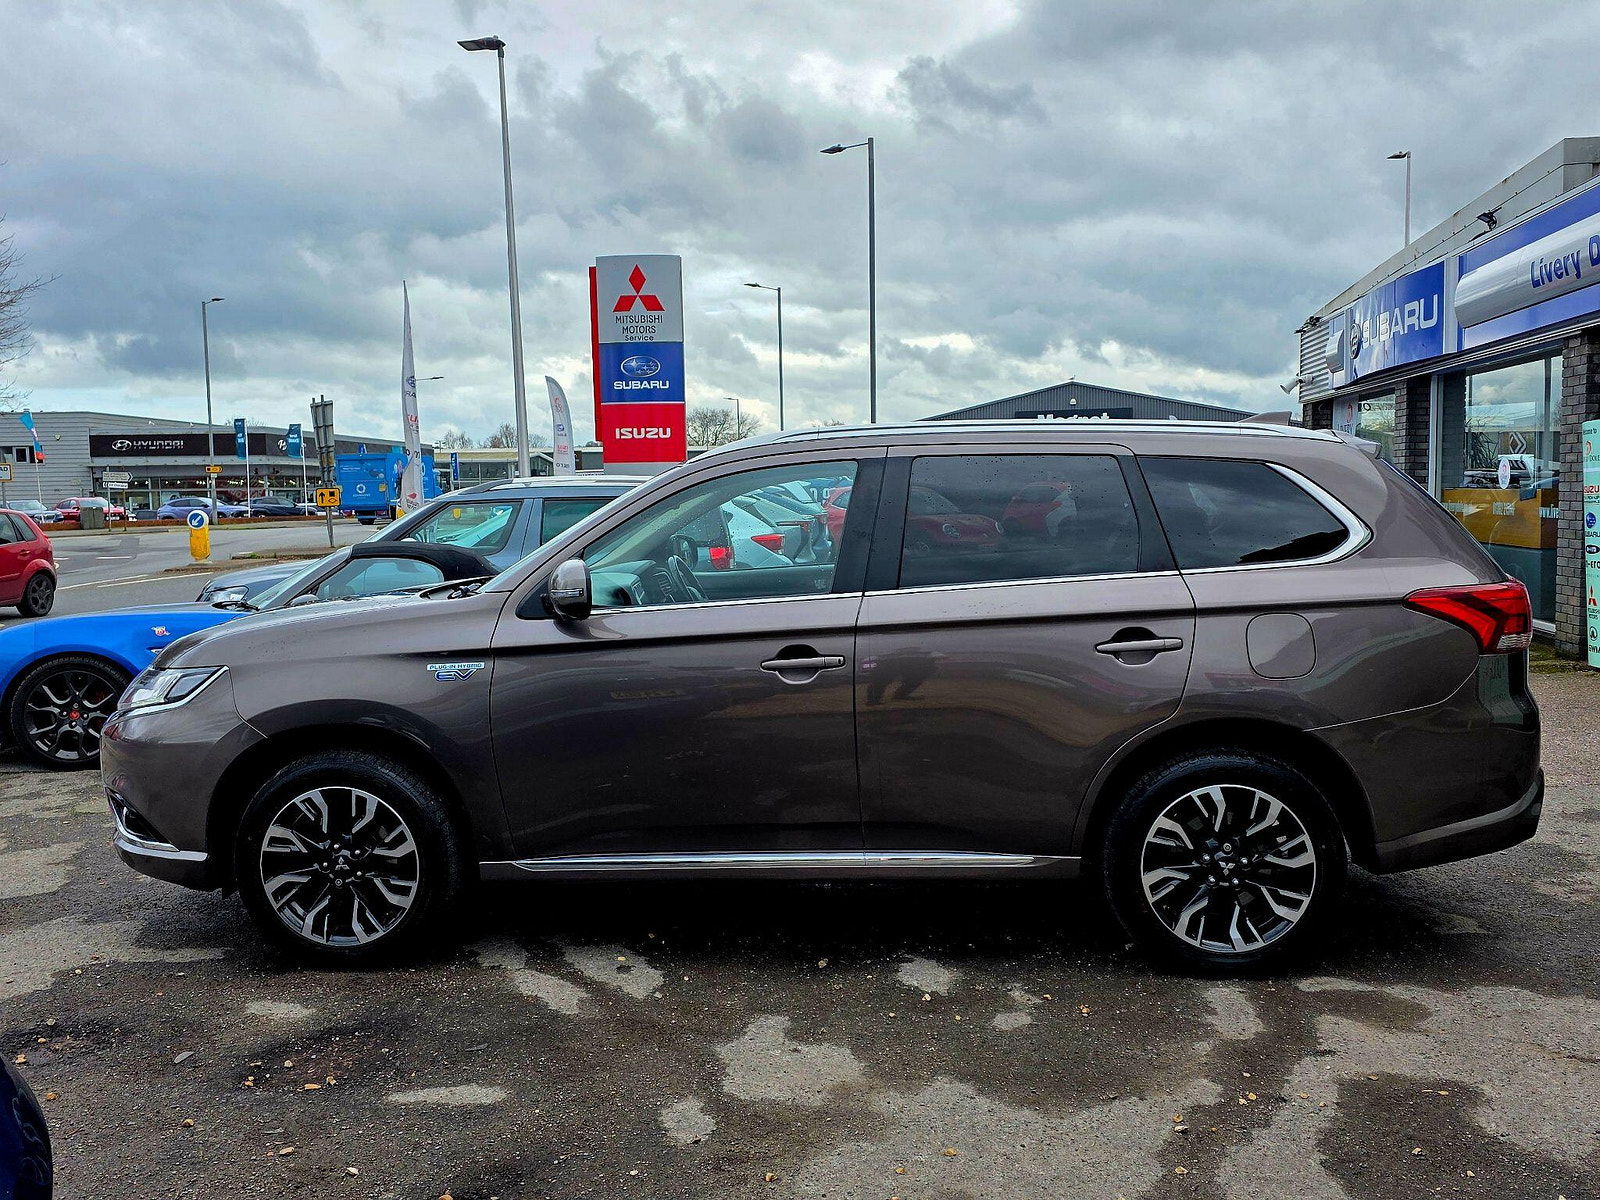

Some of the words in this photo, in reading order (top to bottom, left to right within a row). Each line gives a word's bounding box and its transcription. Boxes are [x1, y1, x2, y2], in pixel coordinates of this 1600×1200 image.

[1530, 250, 1581, 288] Livery
[1589, 235, 1600, 267] D
[615, 314, 663, 324] MITSUBISHI
[1361, 294, 1439, 349] SUBARU
[622, 325, 657, 334] MOTORS
[613, 380, 670, 390] SUBARU
[615, 427, 671, 439] ISUZU
[133, 440, 184, 449] HYUNDAI
[434, 669, 477, 681] EV
